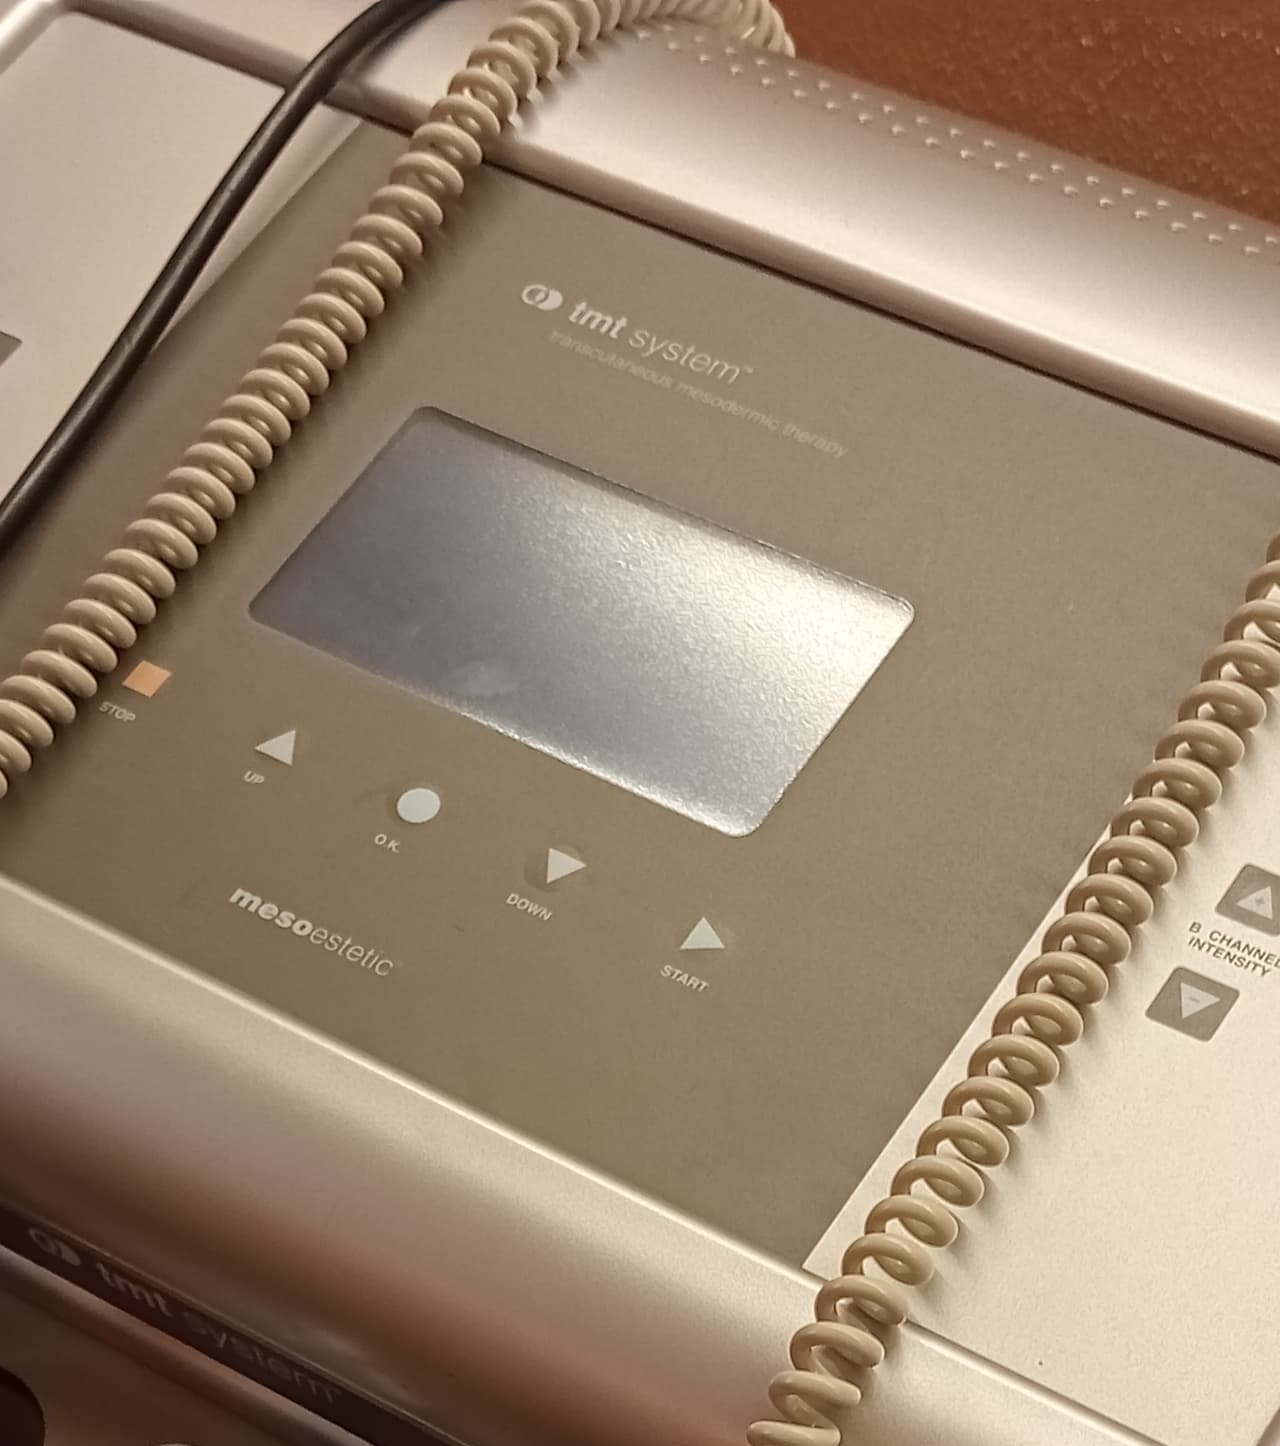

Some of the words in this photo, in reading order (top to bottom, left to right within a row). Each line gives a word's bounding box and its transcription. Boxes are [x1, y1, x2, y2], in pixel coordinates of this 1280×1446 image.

[567, 301, 627, 339] tmt
[675, 379, 780, 433] mesodermic
[781, 421, 849, 459] therapy
[98, 701, 137, 723] STOP
[243, 771, 265, 785] UP
[505, 893, 552, 921] DOWN
[228, 887, 394, 977] mesoestetic
[1188, 921, 1202, 934] B
[1187, 936, 1272, 978] INTENSITY
[659, 964, 710, 993] START
